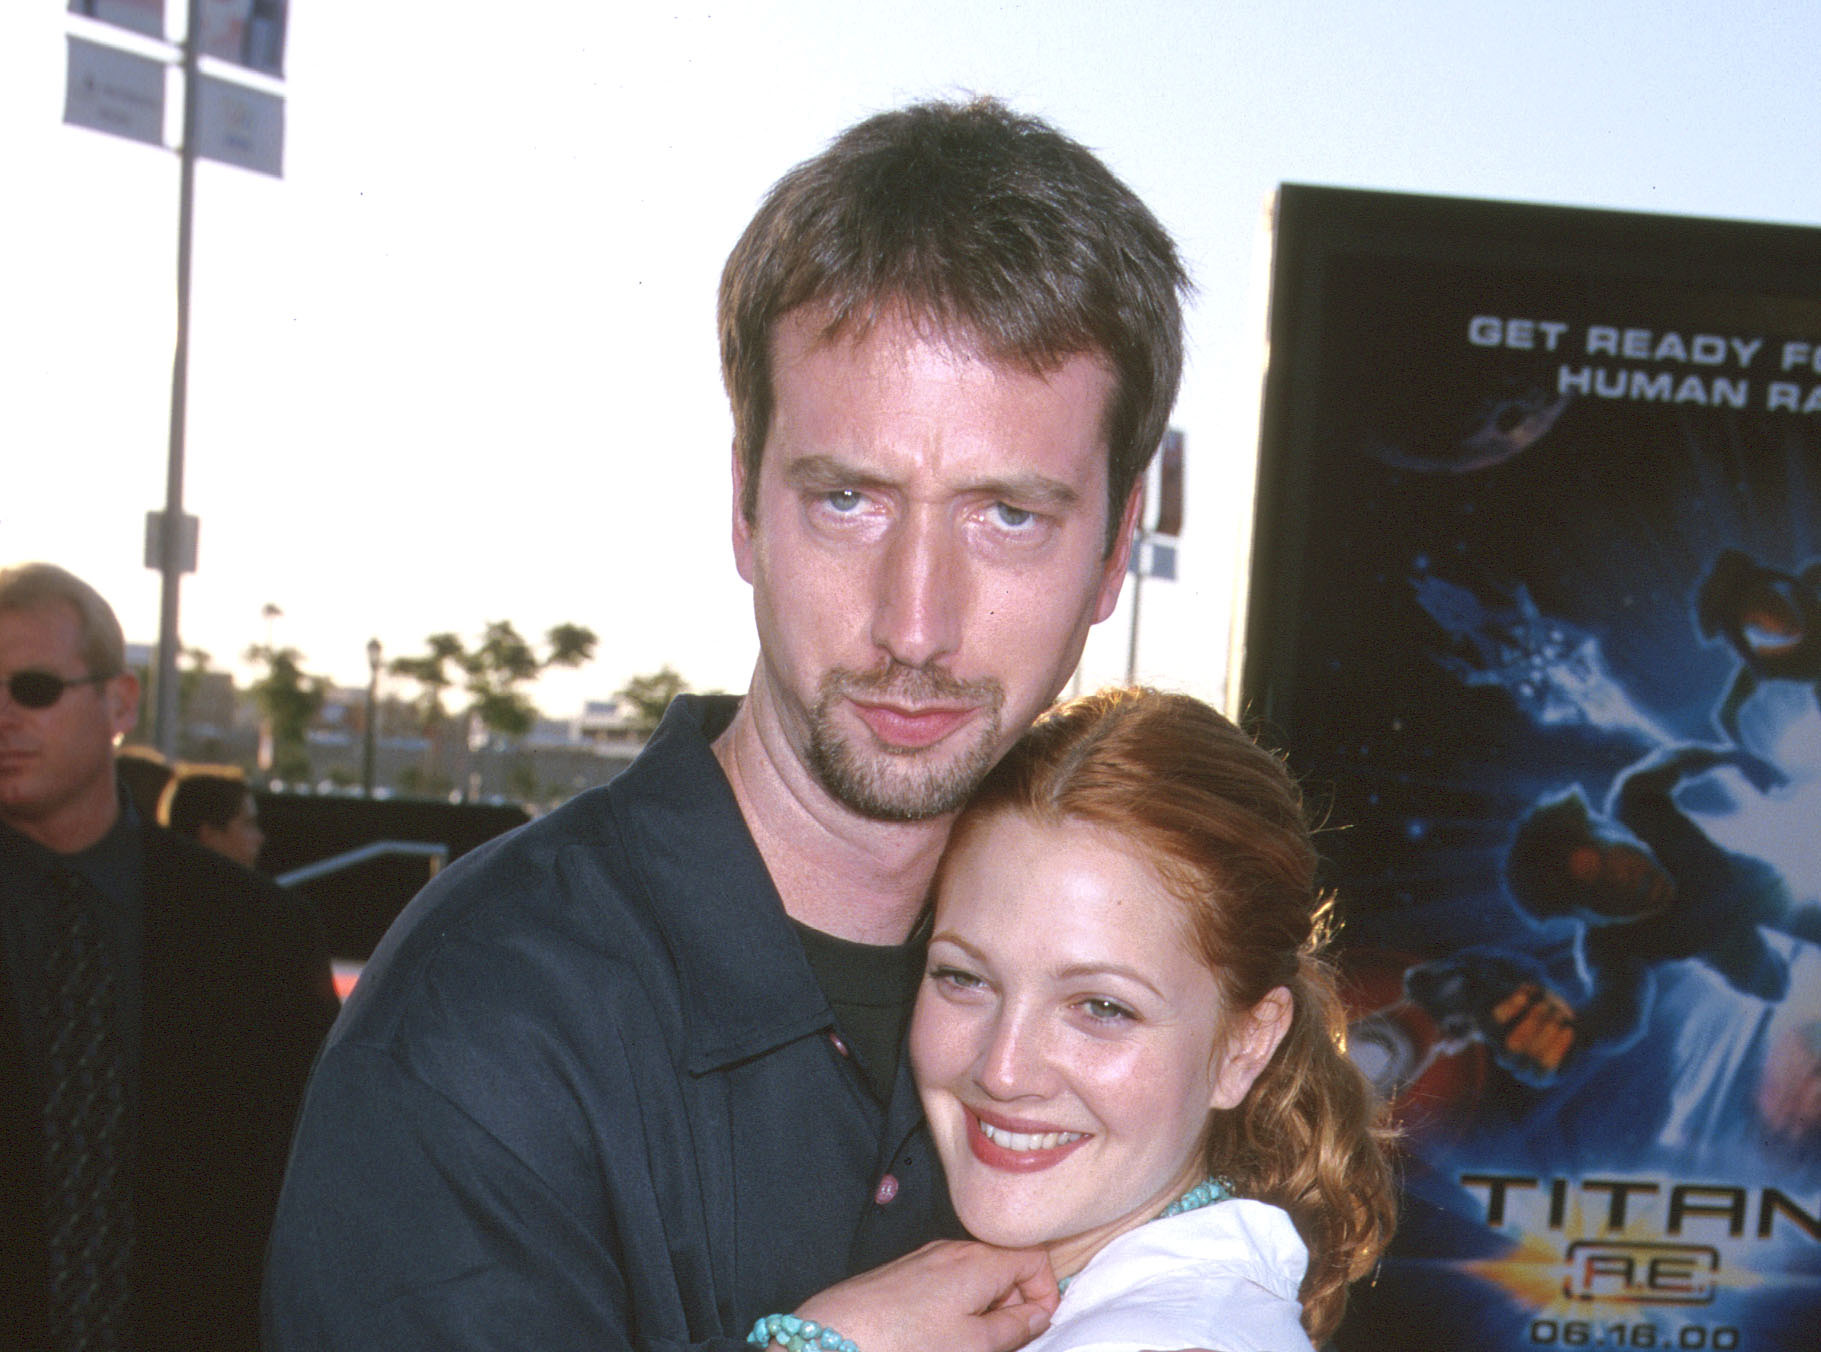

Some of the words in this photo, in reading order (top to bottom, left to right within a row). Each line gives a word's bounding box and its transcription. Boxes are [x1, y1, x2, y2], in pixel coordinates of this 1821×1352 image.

[1468, 315, 1567, 350] GET
[1586, 325, 1761, 368] READY
[1781, 341, 1821, 373] F
[1558, 364, 1748, 409] HUMAN
[1460, 1174, 1821, 1241] TITAN
[1530, 1319, 1740, 1351] 06.16.00
